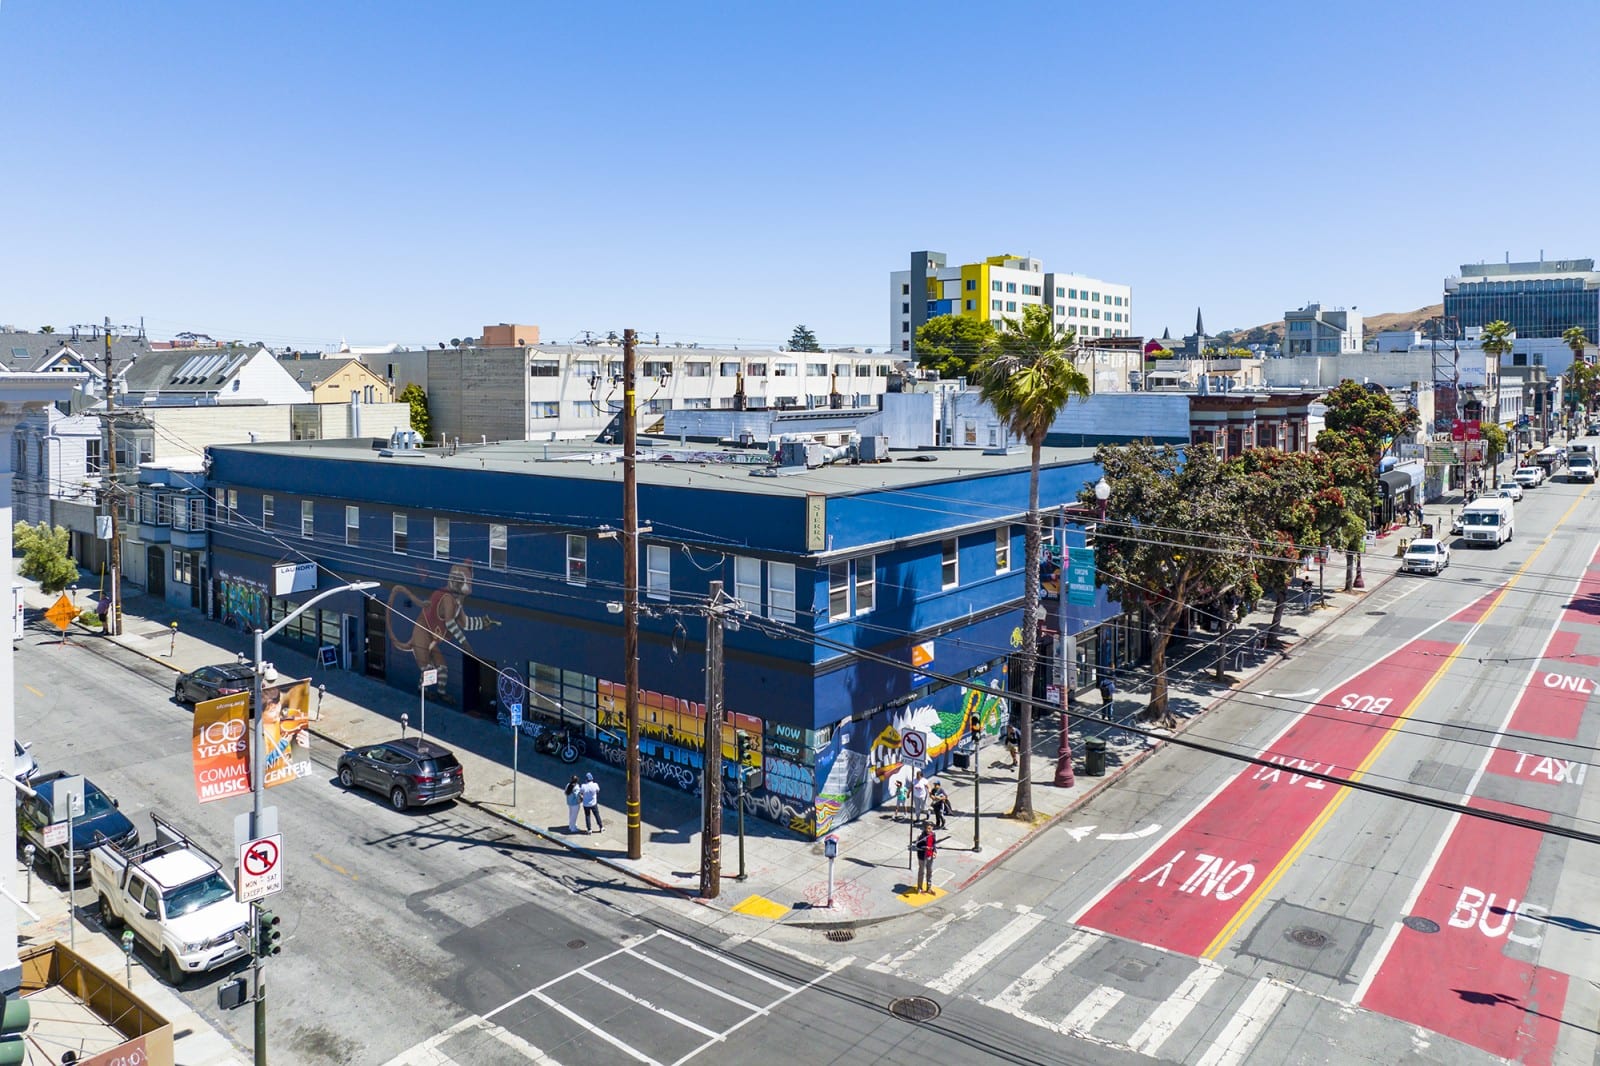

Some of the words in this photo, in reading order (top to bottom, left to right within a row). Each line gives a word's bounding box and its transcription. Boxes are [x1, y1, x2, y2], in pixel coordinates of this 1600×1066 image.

[813, 504, 821, 541] SIERRA
[280, 564, 315, 574] LAUNDRY
[1336, 693, 1394, 715] BUS
[198, 719, 246, 747] 100
[776, 724, 801, 740] NOW
[197, 740, 247, 758] YEARS
[201, 778, 246, 798] MUSIC
[264, 760, 307, 784] CENTER
[1252, 756, 1336, 790] TAXI
[1514, 750, 1588, 785] TAXI
[245, 880, 258, 888] MON
[267, 873, 278, 881] SAT
[1138, 850, 1256, 901] ONLY
[244, 887, 264, 899] EXCEPT
[1447, 886, 1549, 948] BUS
